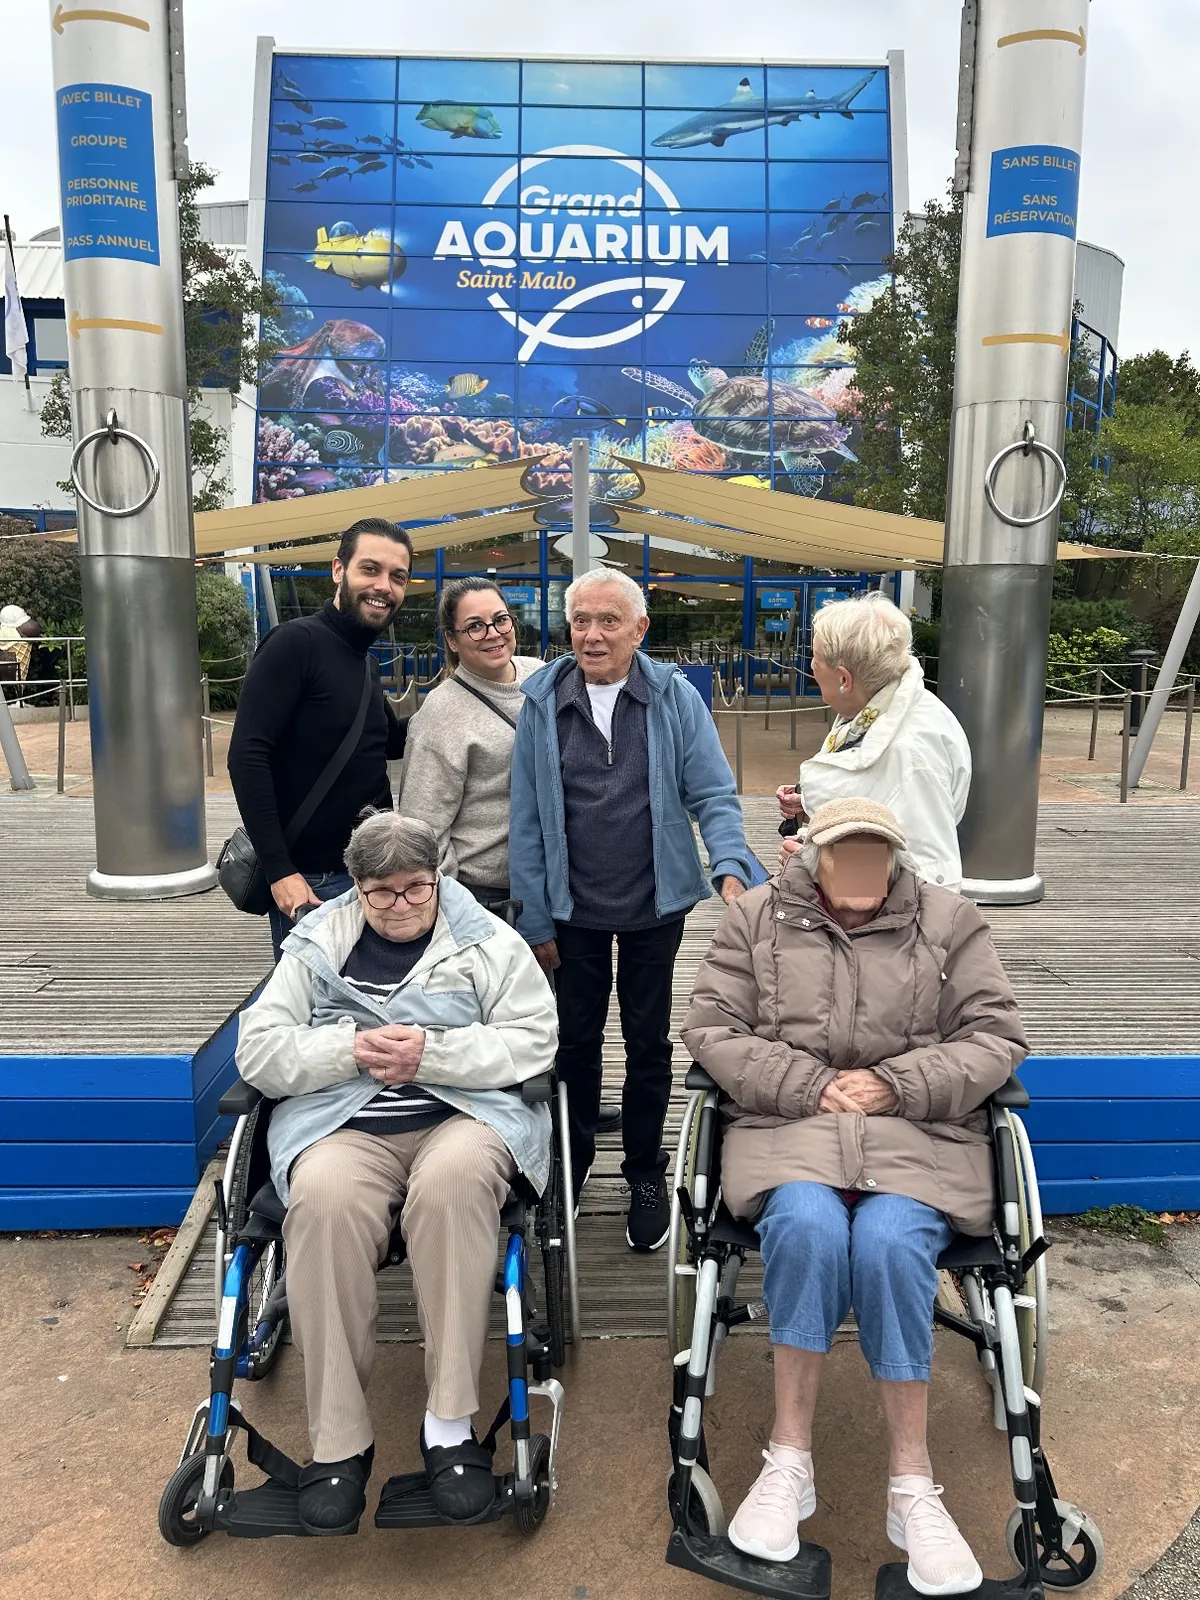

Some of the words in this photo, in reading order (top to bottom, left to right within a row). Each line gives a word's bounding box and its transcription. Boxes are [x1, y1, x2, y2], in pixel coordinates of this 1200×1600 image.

[61, 91, 91, 107] AVEC
[94, 92, 143, 109] BILLET
[70, 134, 128, 149] GROUPE
[1002, 155, 1039, 170] SANS
[1042, 155, 1077, 173] BILLET
[67, 177, 140, 194] PERSONNE
[66, 194, 148, 212] PRIORITAIRE
[520, 184, 643, 218] Grand
[1022, 194, 1058, 206] SANS
[993, 209, 1076, 228] RÉSERVATION
[67, 234, 94, 249] PASS
[96, 235, 155, 253] ANNUEL
[432, 220, 730, 269] AQUARIUM
[456, 269, 577, 290] Saint-Malo
